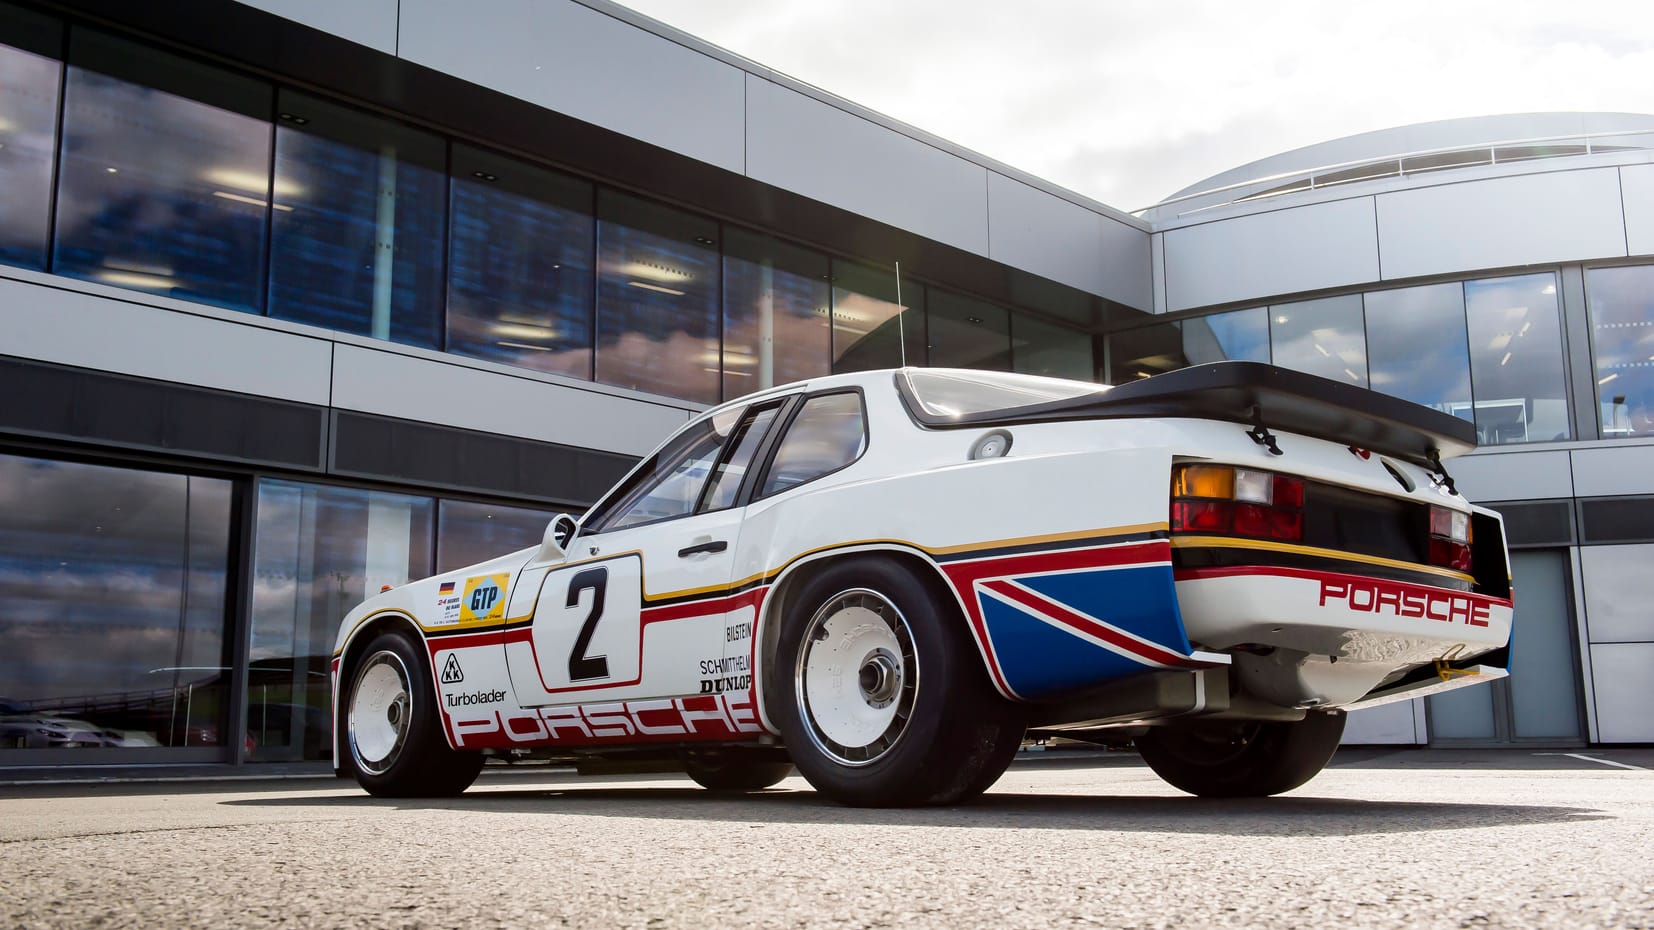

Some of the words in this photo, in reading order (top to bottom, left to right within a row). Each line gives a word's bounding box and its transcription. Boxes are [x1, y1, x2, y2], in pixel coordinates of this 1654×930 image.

[471, 586, 498, 611] GTP
[1319, 581, 1490, 628] PORSCHE
[565, 566, 610, 682] 2
[727, 621, 752, 642] BILSTEIN
[700, 674, 752, 694] DUNLOP
[445, 688, 506, 708] Turbolader
[447, 694, 763, 747] PORSCHE
